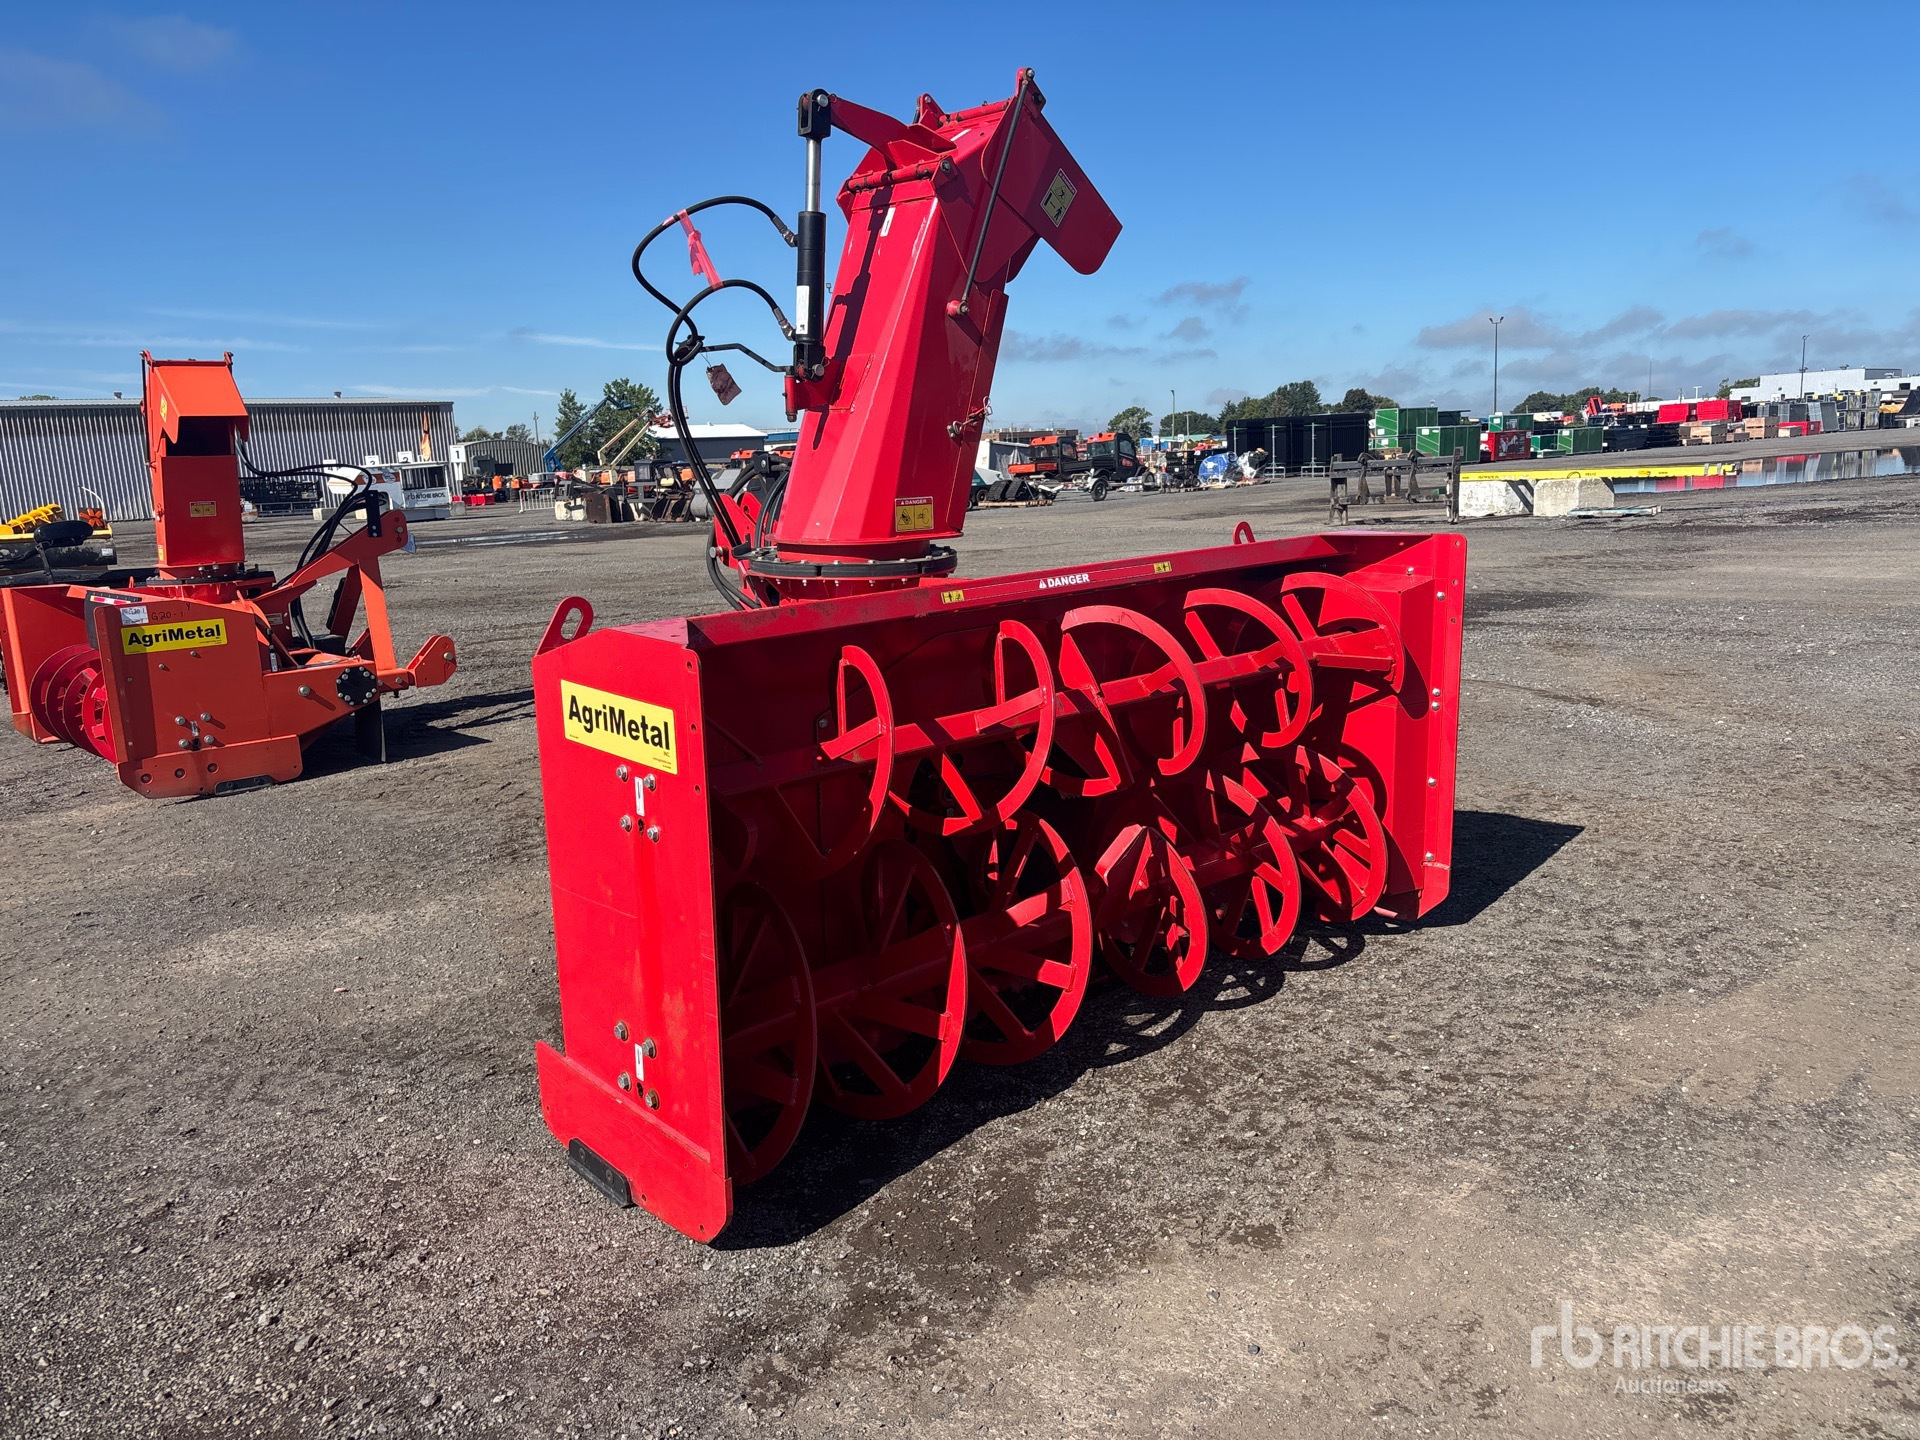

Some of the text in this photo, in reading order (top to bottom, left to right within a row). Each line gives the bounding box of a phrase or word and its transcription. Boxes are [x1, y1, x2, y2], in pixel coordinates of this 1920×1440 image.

[455, 450, 460, 460] 1
[1047, 573, 1090, 588] DANGER
[128, 624, 221, 647] AgriMetal
[568, 694, 670, 750] AgriMetal
